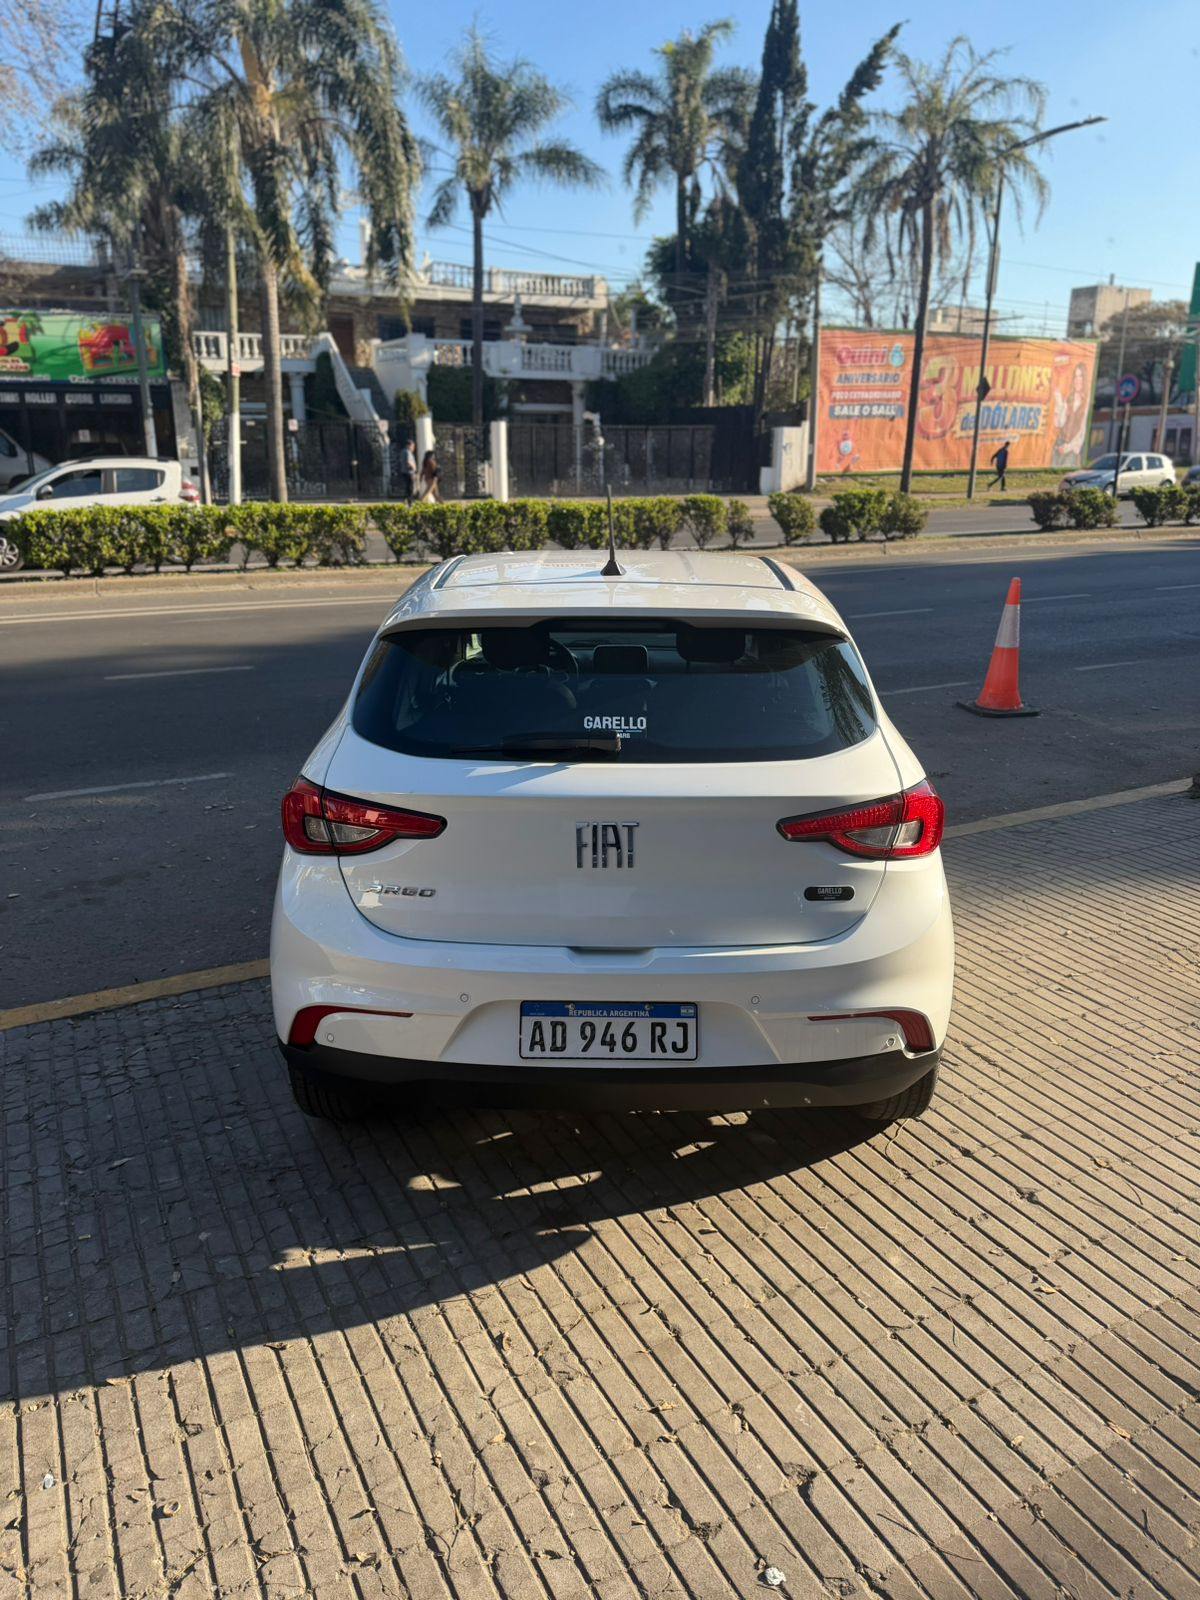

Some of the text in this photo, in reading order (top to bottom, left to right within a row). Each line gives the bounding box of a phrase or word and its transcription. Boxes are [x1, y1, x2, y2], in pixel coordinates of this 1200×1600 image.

[890, 344, 905, 367] 6
[836, 372, 900, 385] ANIVERSARIO
[961, 365, 1051, 398] MLLONES
[834, 404, 861, 416] SALE
[862, 404, 870, 415] O
[917, 355, 959, 440] 3
[979, 402, 1041, 431] DÓLARES
[583, 716, 647, 729] GARELLO
[576, 822, 639, 868] FIAT
[610, 1009, 650, 1017] ARGENTINA
[529, 1020, 689, 1053] AD 946 RJ
